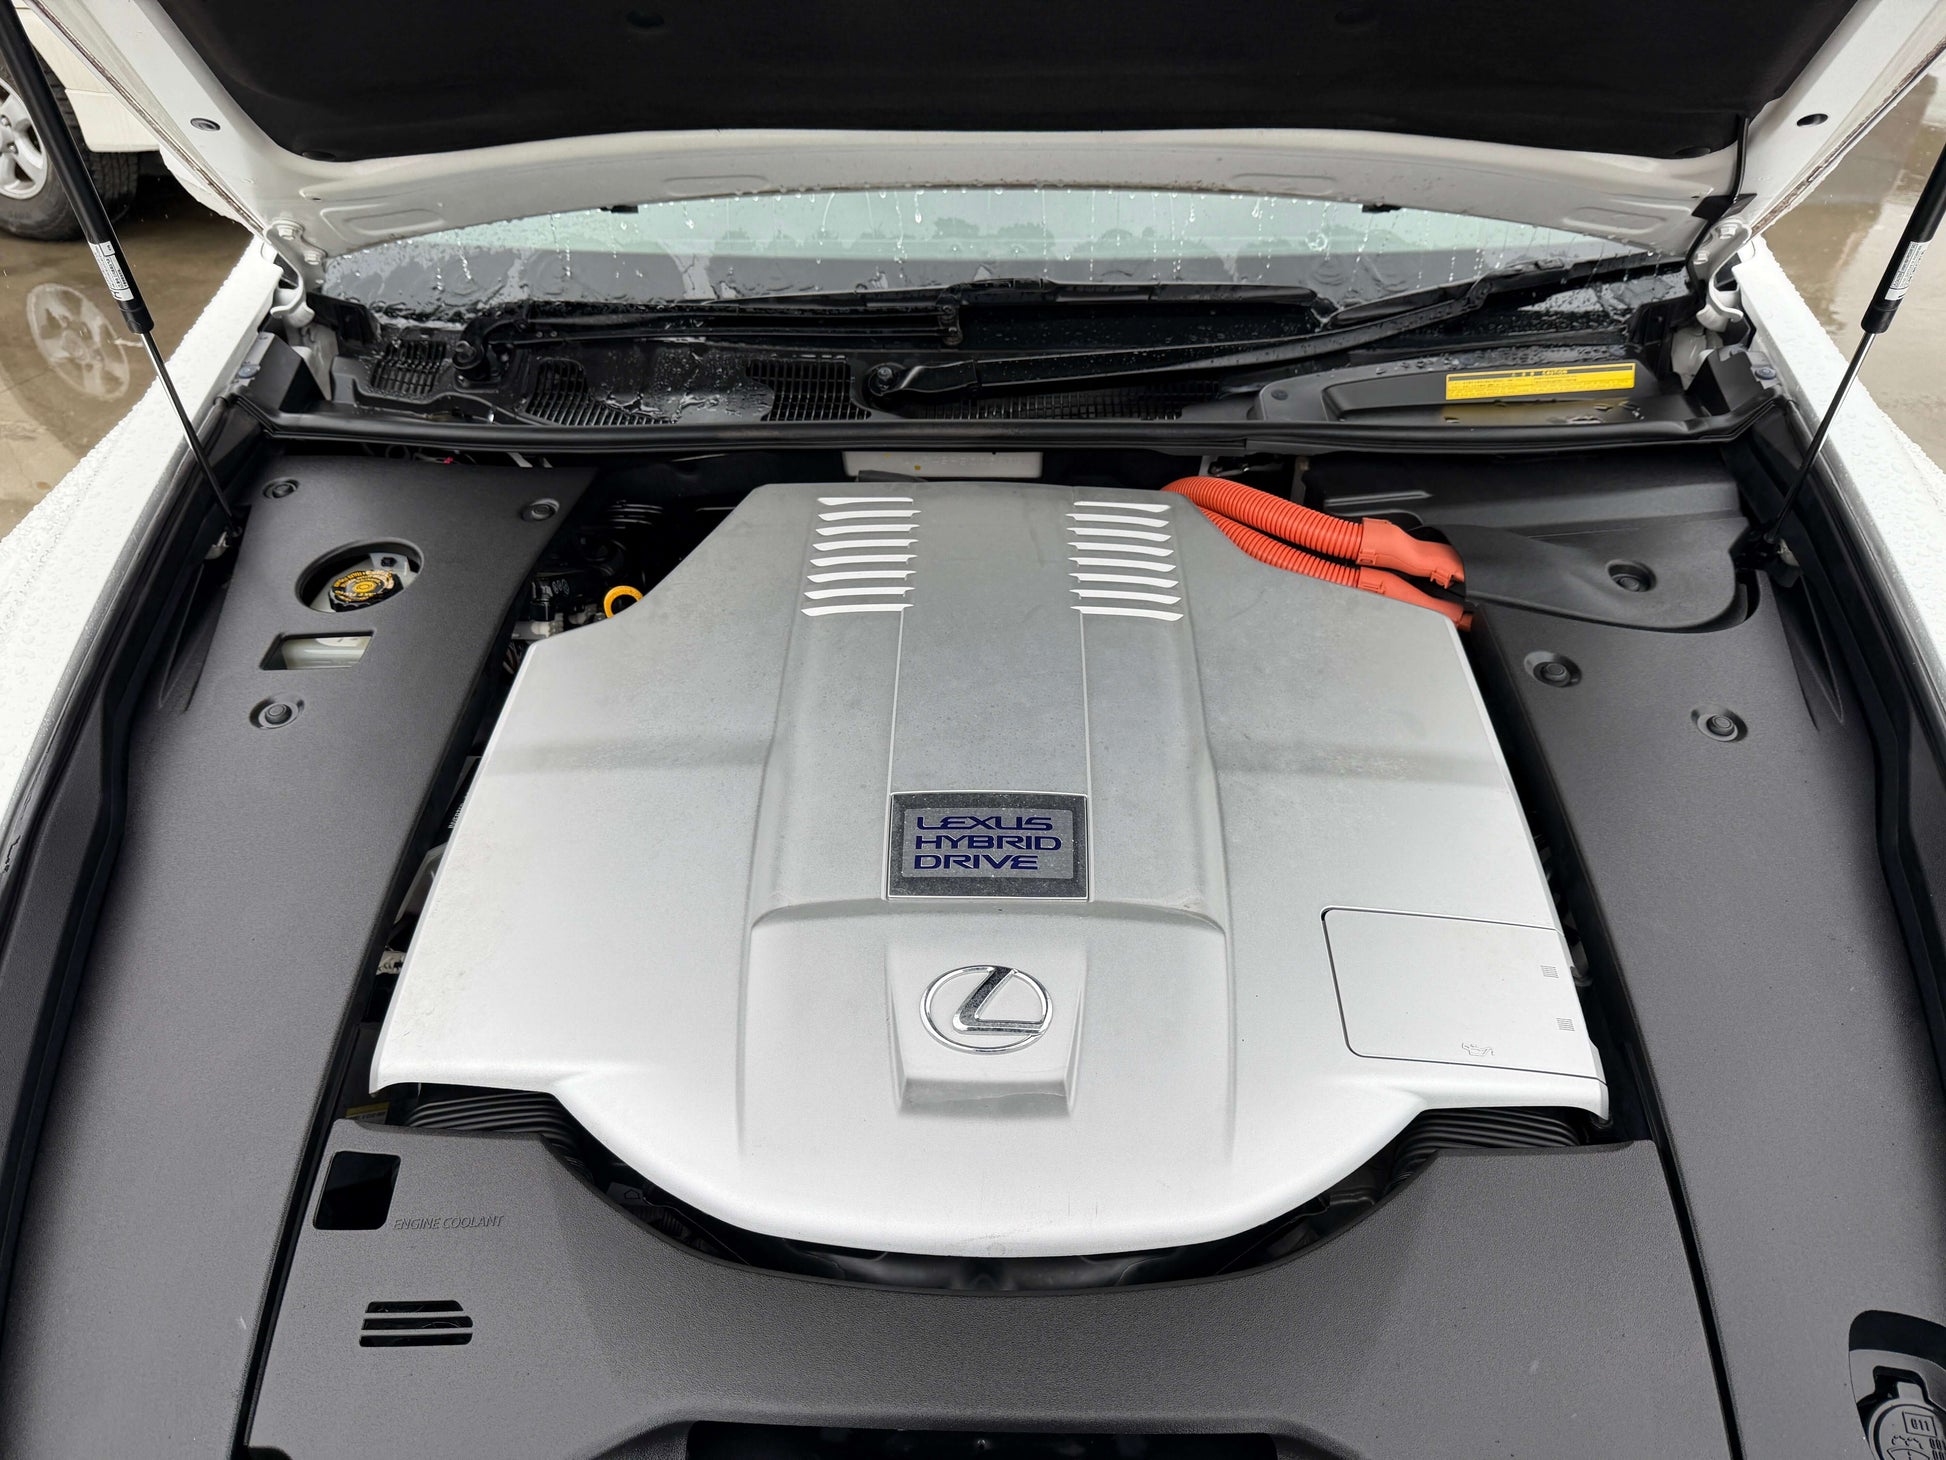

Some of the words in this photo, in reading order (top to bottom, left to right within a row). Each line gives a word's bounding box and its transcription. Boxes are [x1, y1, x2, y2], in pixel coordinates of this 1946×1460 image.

[917, 816, 1053, 831] LEXUS
[915, 835, 1062, 850] HYBRID
[914, 854, 1039, 870] DRIVE
[394, 1218, 440, 1230] ENGINE
[443, 1216, 504, 1229] COOLANT
